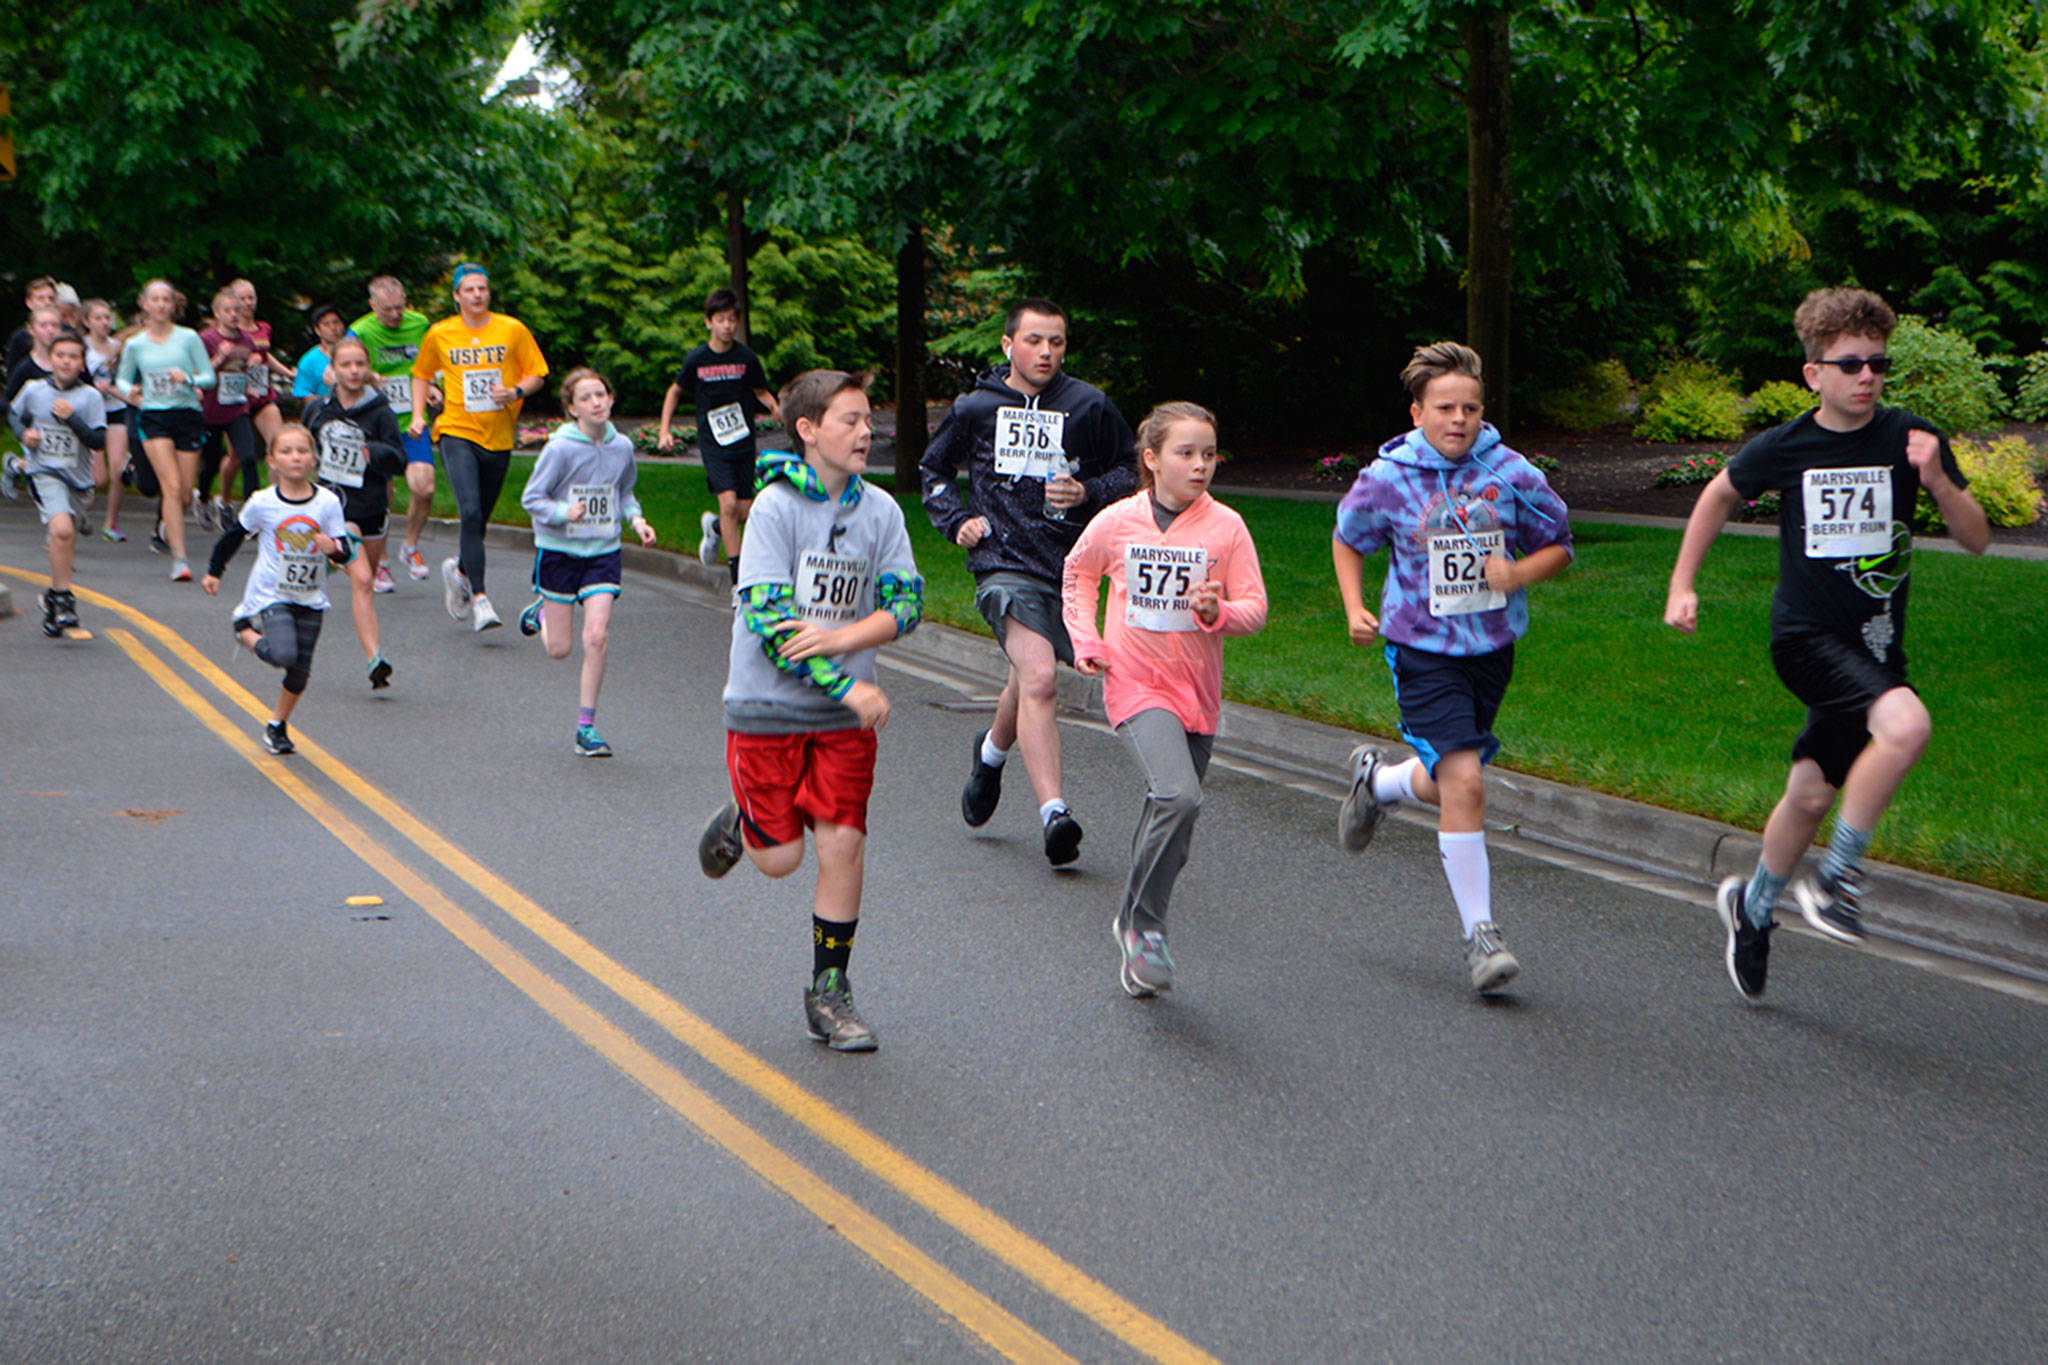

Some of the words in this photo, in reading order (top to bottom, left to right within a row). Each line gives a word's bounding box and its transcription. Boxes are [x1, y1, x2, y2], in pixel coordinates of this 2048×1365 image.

[716, 412, 739, 430] 615
[1810, 470, 1886, 486] MARYSVILLE
[578, 496, 608, 517] 08
[1821, 487, 1875, 521] 574
[1812, 523, 1855, 536] BERRY
[1859, 521, 1886, 534] RUN
[1433, 534, 1501, 551] MARYSVILLE
[1130, 547, 1202, 564] MARYSVILLE
[287, 563, 318, 584] 624
[1138, 562, 1191, 597] 575
[811, 572, 858, 605] 580
[1435, 583, 1474, 596] BERRY
[1478, 580, 1491, 592] RU
[1132, 595, 1169, 611] BERRY
[1172, 598, 1190, 611] RU
